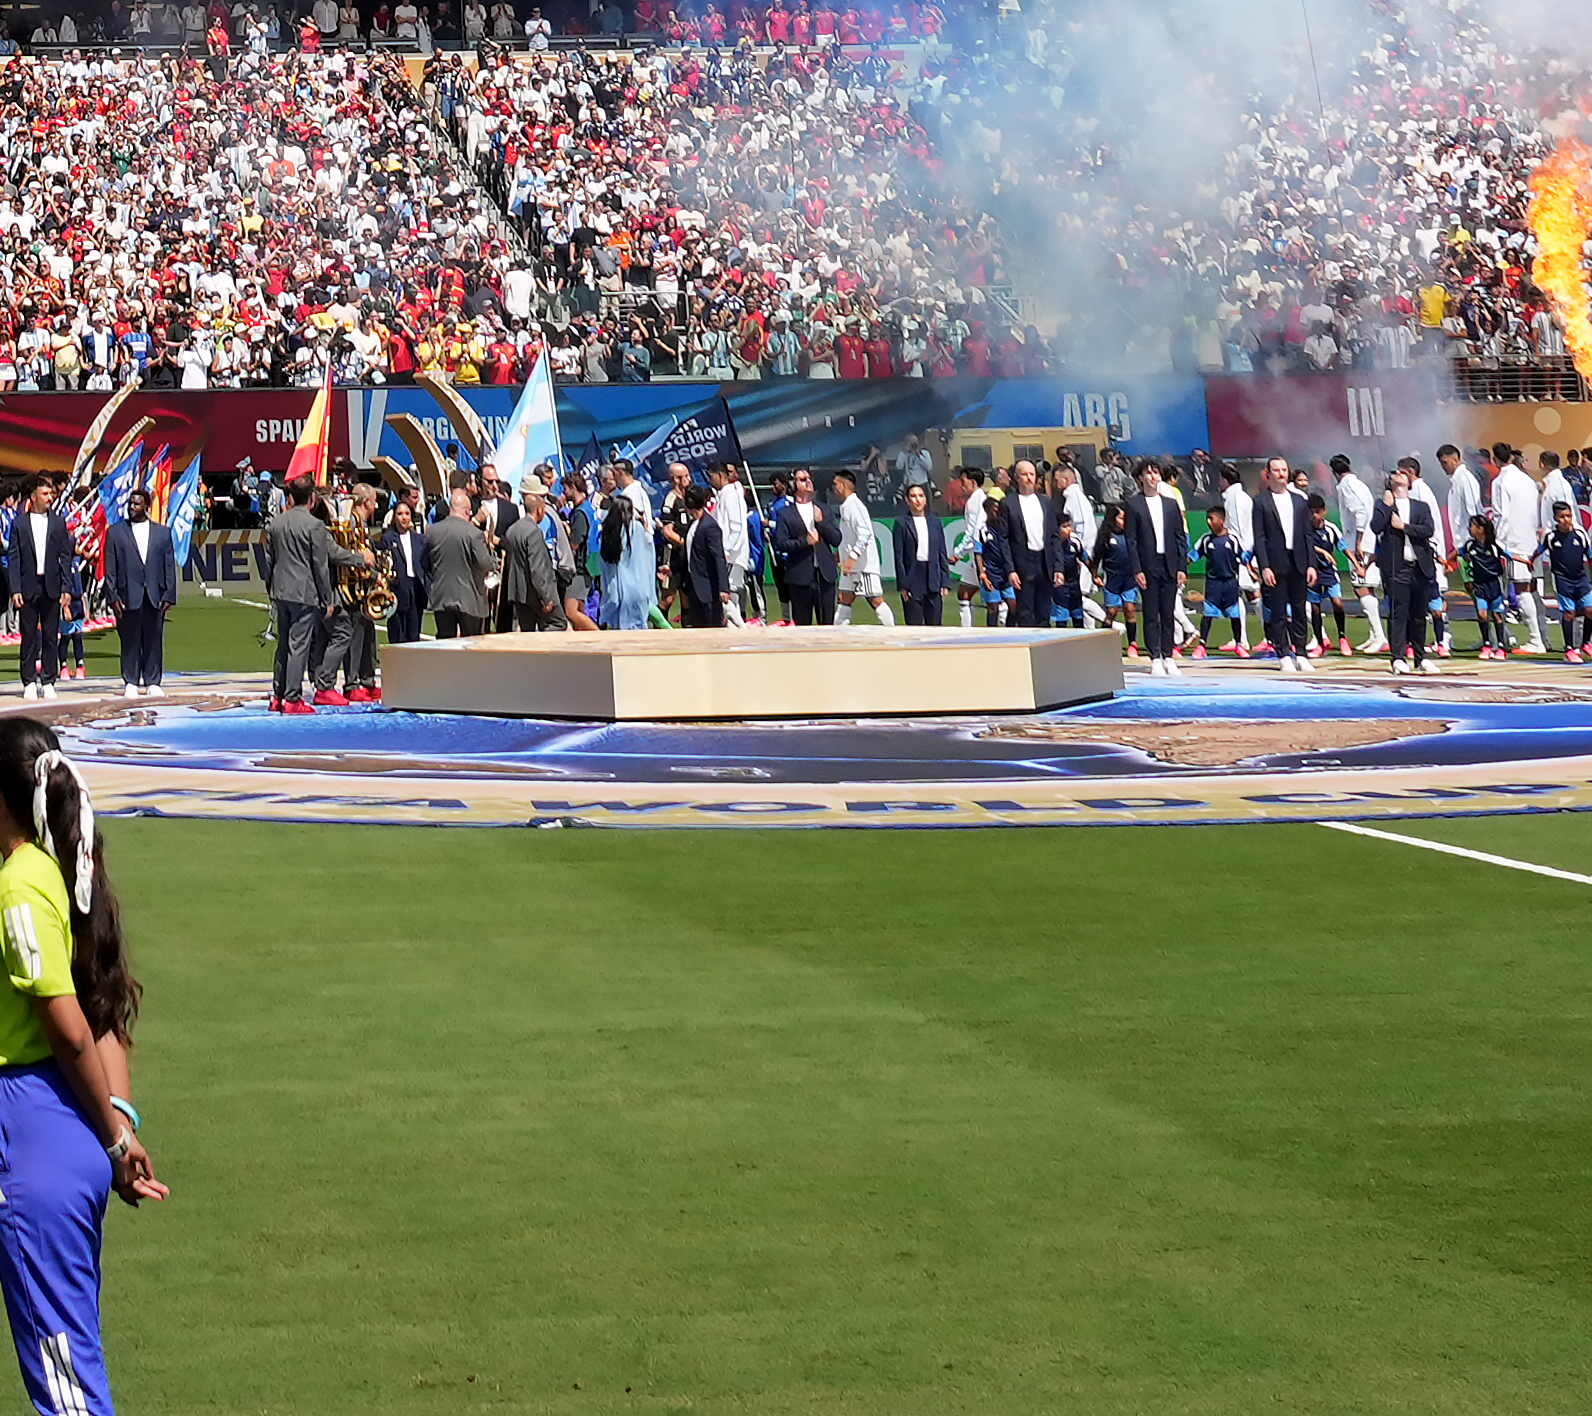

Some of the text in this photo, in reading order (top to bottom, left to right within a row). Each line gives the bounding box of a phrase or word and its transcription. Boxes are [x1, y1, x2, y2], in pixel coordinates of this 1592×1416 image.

[1061, 391, 1132, 443] ARG
[1347, 385, 1386, 438] IN
[106, 788, 469, 810] FIFA
[531, 797, 1209, 813] WORLD
[1240, 783, 1575, 804] CUP
